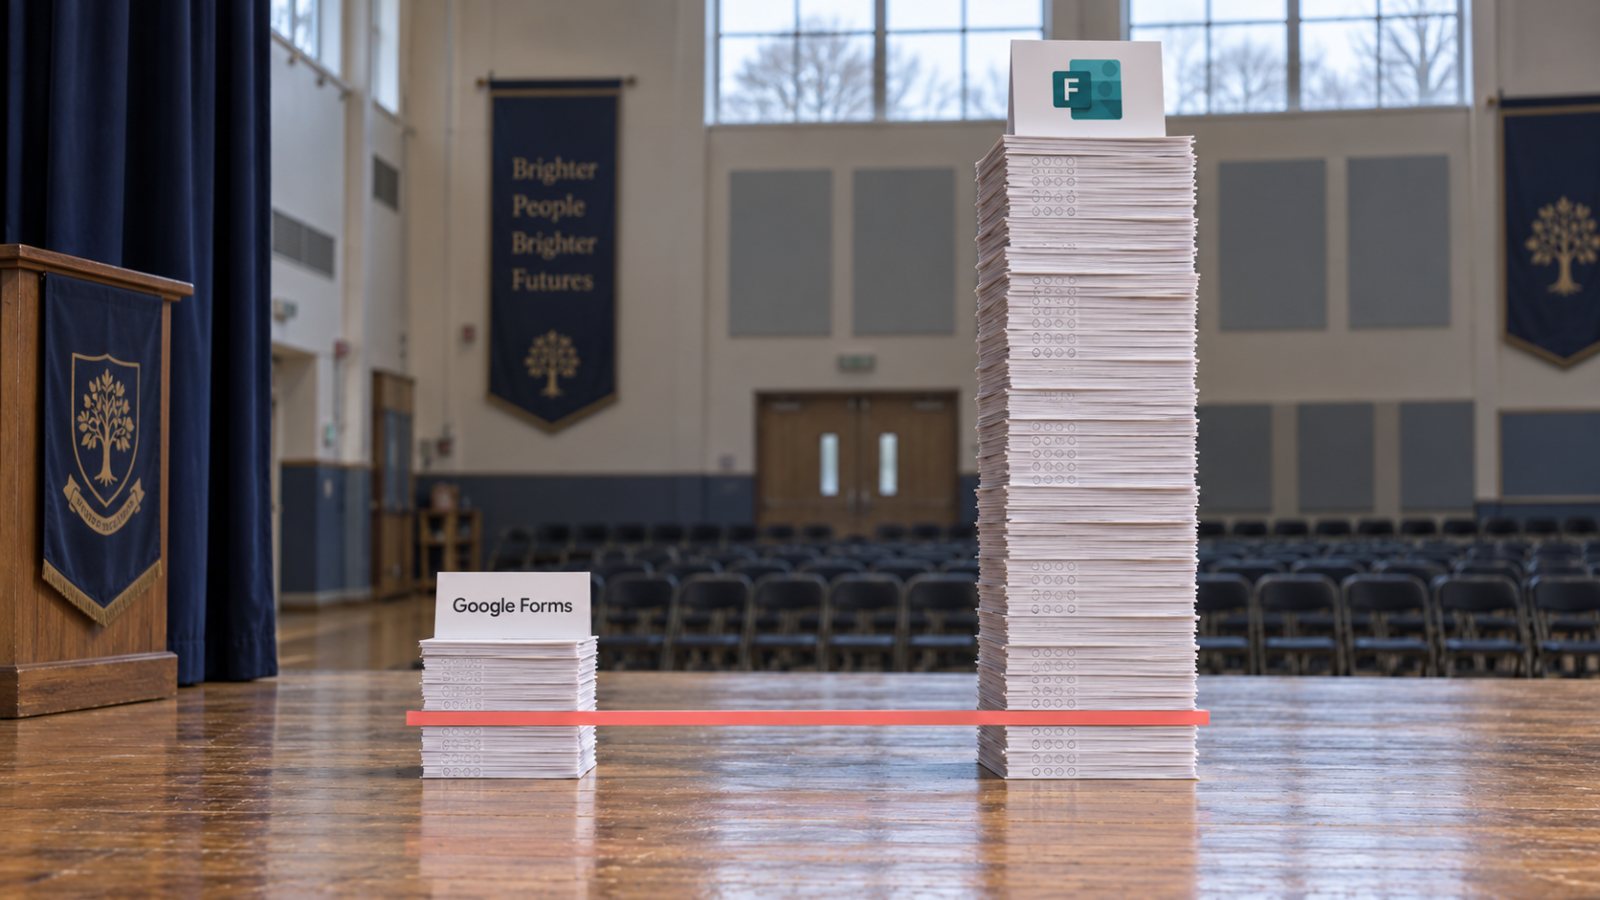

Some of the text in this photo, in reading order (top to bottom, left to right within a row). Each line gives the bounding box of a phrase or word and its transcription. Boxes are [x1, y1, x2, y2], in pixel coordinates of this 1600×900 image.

[1064, 78, 1079, 101] F
[512, 156, 598, 186] Brighter
[512, 193, 586, 223] People
[511, 230, 598, 260] Brighter
[511, 267, 594, 292] Futures
[453, 597, 573, 617] Google Forms
